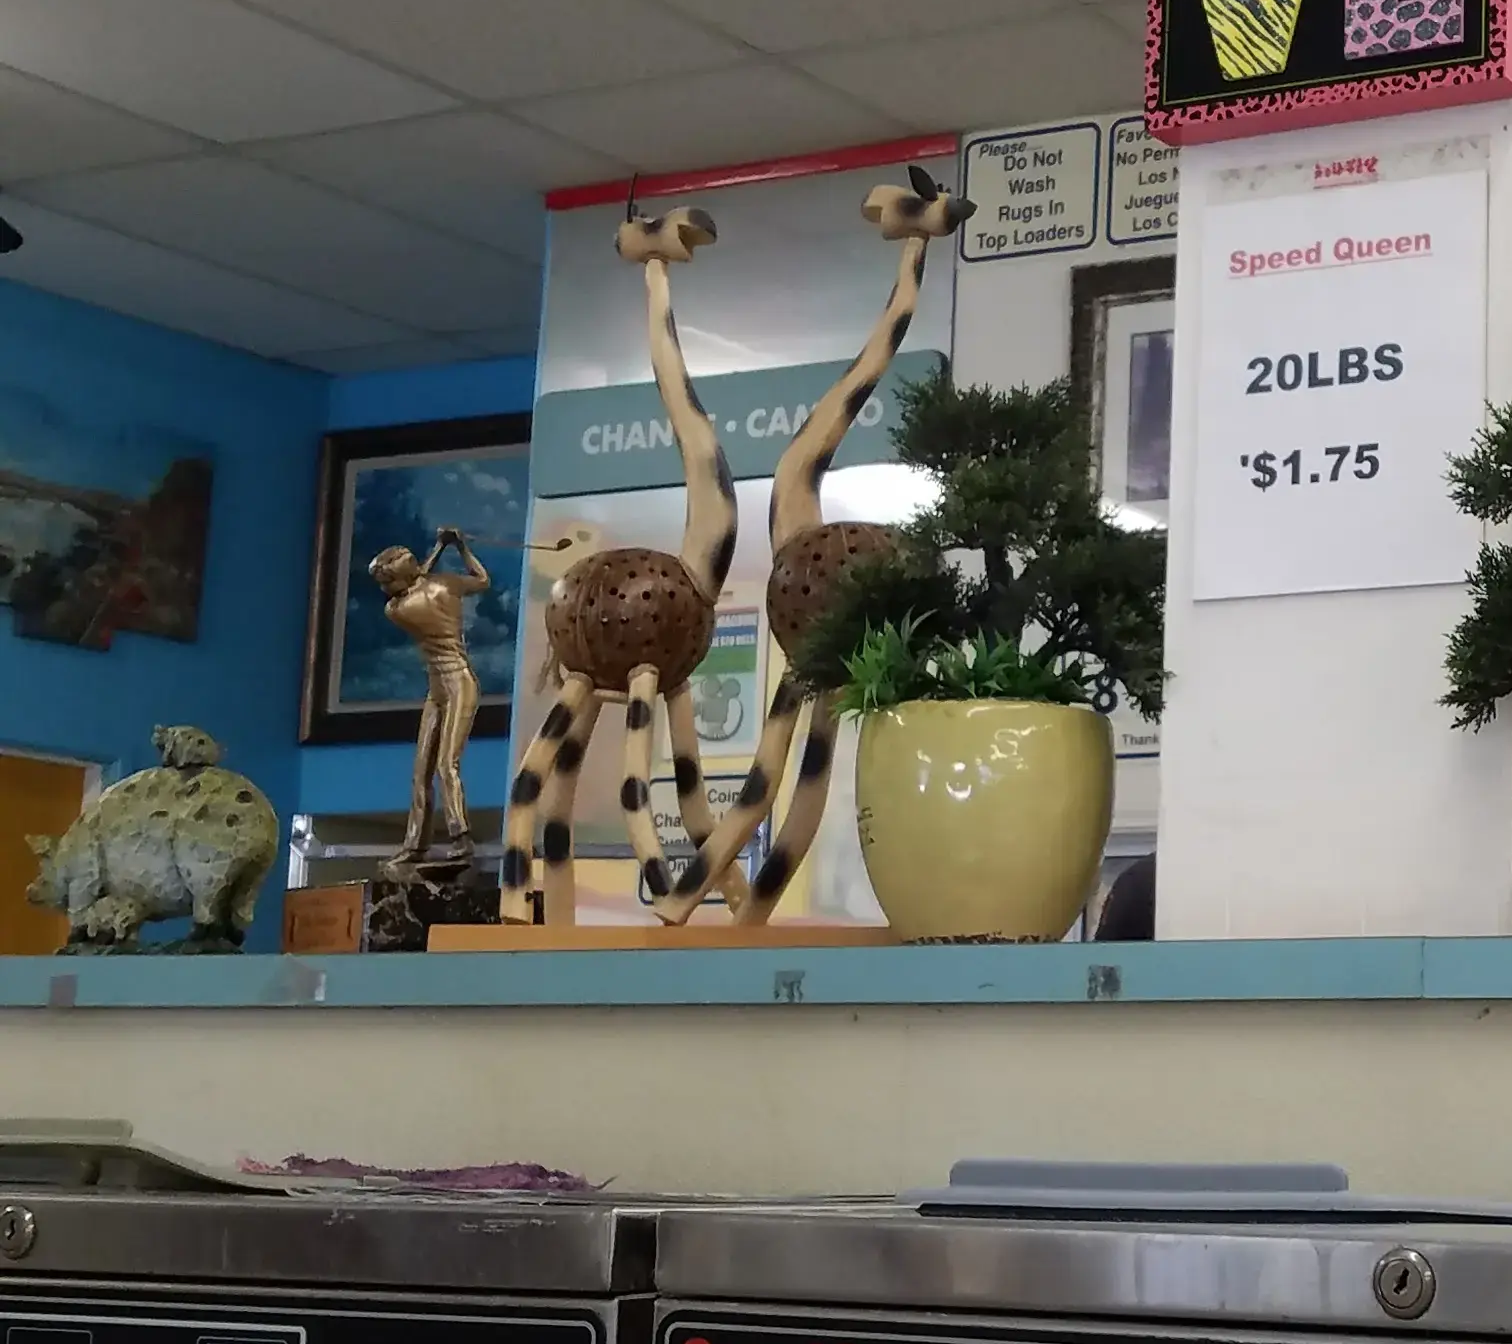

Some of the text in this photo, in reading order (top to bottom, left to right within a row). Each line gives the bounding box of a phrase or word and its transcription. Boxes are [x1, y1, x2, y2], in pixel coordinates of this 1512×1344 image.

[1117, 129, 1151, 144] Favo
[1004, 150, 1063, 171] Do Not
[1116, 152, 1137, 166] No
[1009, 176, 1055, 196] Wash
[1139, 172, 1167, 185] Los
[1124, 192, 1179, 210] Juegue
[999, 200, 1064, 223] Rugs In
[1132, 216, 1161, 232] Los
[977, 224, 1085, 250] Top Loaders
[1229, 232, 1432, 277] Speed Queen
[1245, 343, 1404, 395] 20LBS
[581, 414, 716, 455] CHAN
[1121, 733, 1160, 748] Thank
